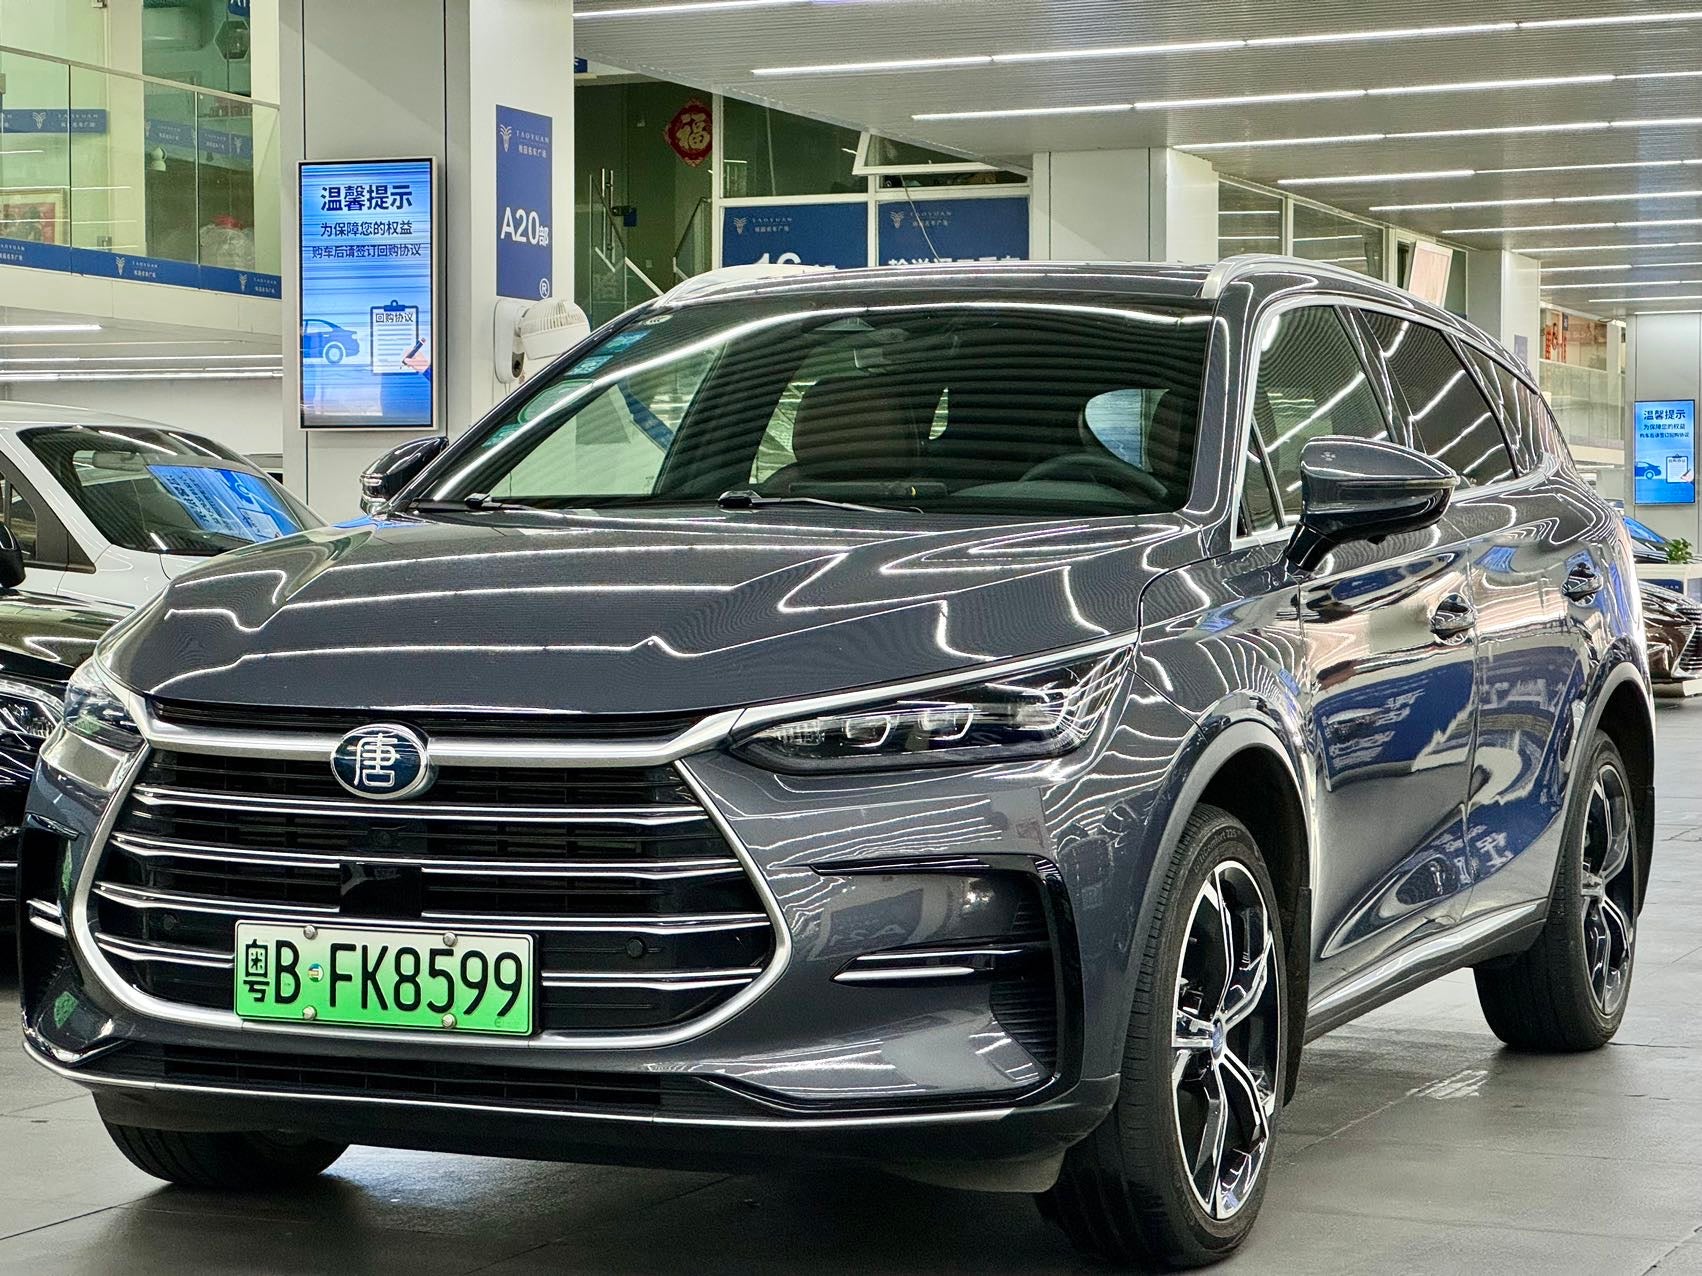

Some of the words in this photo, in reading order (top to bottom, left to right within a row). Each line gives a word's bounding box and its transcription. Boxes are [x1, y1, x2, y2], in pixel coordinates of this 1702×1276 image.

[676, 112, 711, 150] 福
[320, 184, 413, 211] 温馨提示
[320, 221, 413, 237] 为保障您的权益
[500, 206, 549, 247] A20部
[312, 243, 422, 259] 购车后请签订回购协议
[375, 312, 414, 323] 回购协议
[1643, 409, 1686, 420] 温馨提示
[353, 732, 401, 787] 唐
